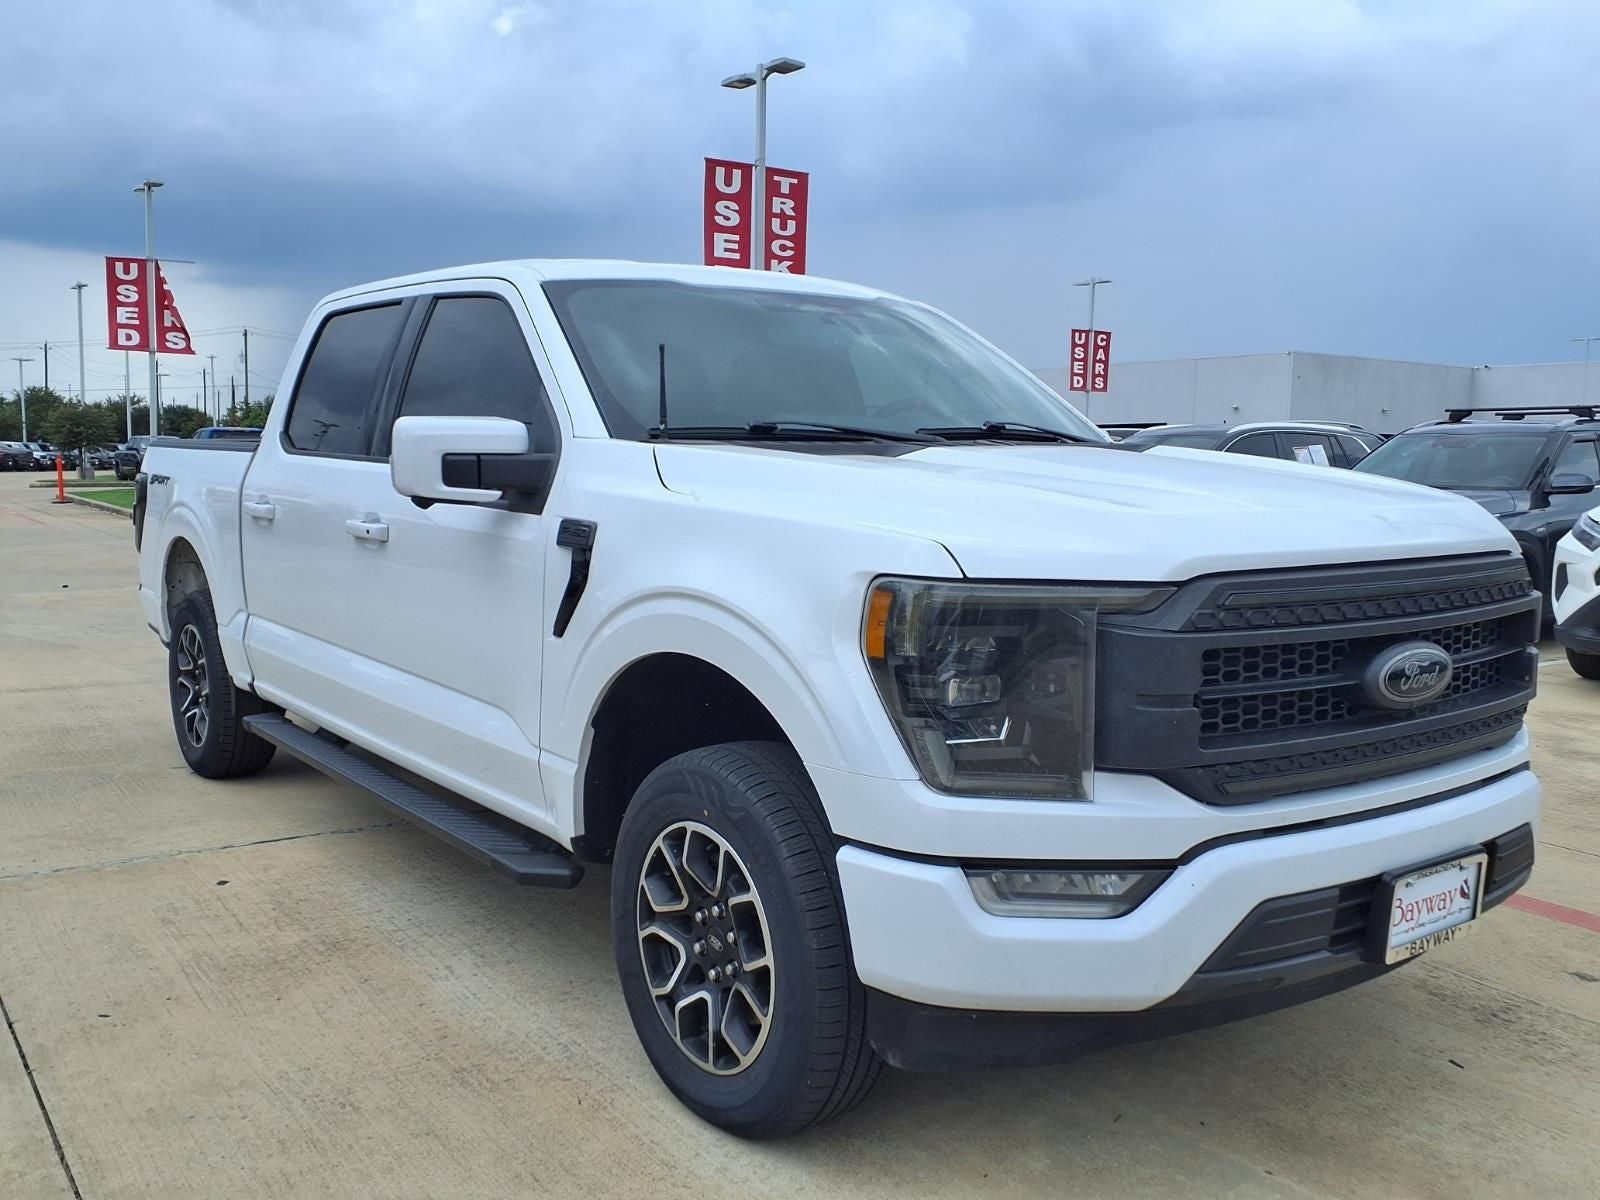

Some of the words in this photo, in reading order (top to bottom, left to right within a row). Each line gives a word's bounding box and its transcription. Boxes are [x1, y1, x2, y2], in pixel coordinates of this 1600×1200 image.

[714, 166, 742, 267] USE
[115, 261, 140, 346] USED
[1073, 332, 1086, 388] USED
[1094, 334, 1107, 388] CARS
[1400, 661, 1440, 691] Ford
[1409, 926, 1458, 956] BAYWAY
